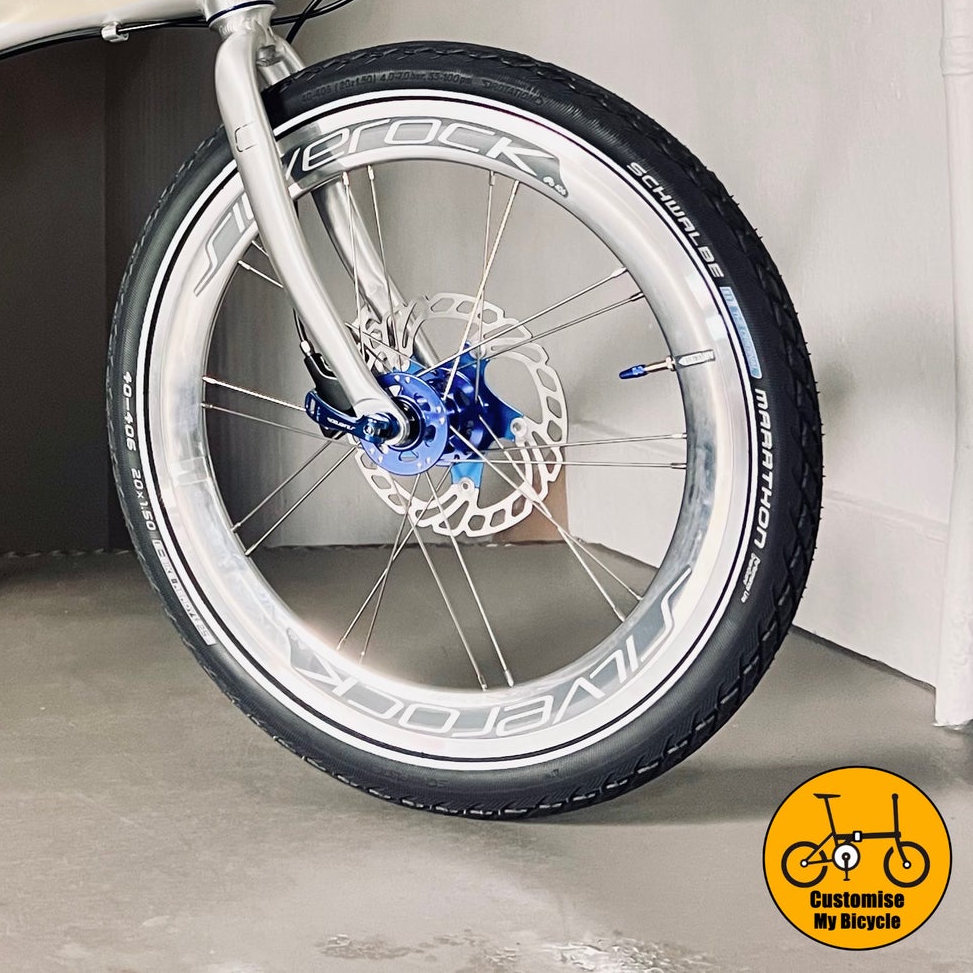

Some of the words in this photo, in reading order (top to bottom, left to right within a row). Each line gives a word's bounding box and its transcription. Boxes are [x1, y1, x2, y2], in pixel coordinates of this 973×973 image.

[627, 160, 724, 279] SCHWALBE
[122, 371, 137, 452] 40-406
[131, 467, 157, 532] 20x1.50
[754, 388, 774, 550] MARATHON
